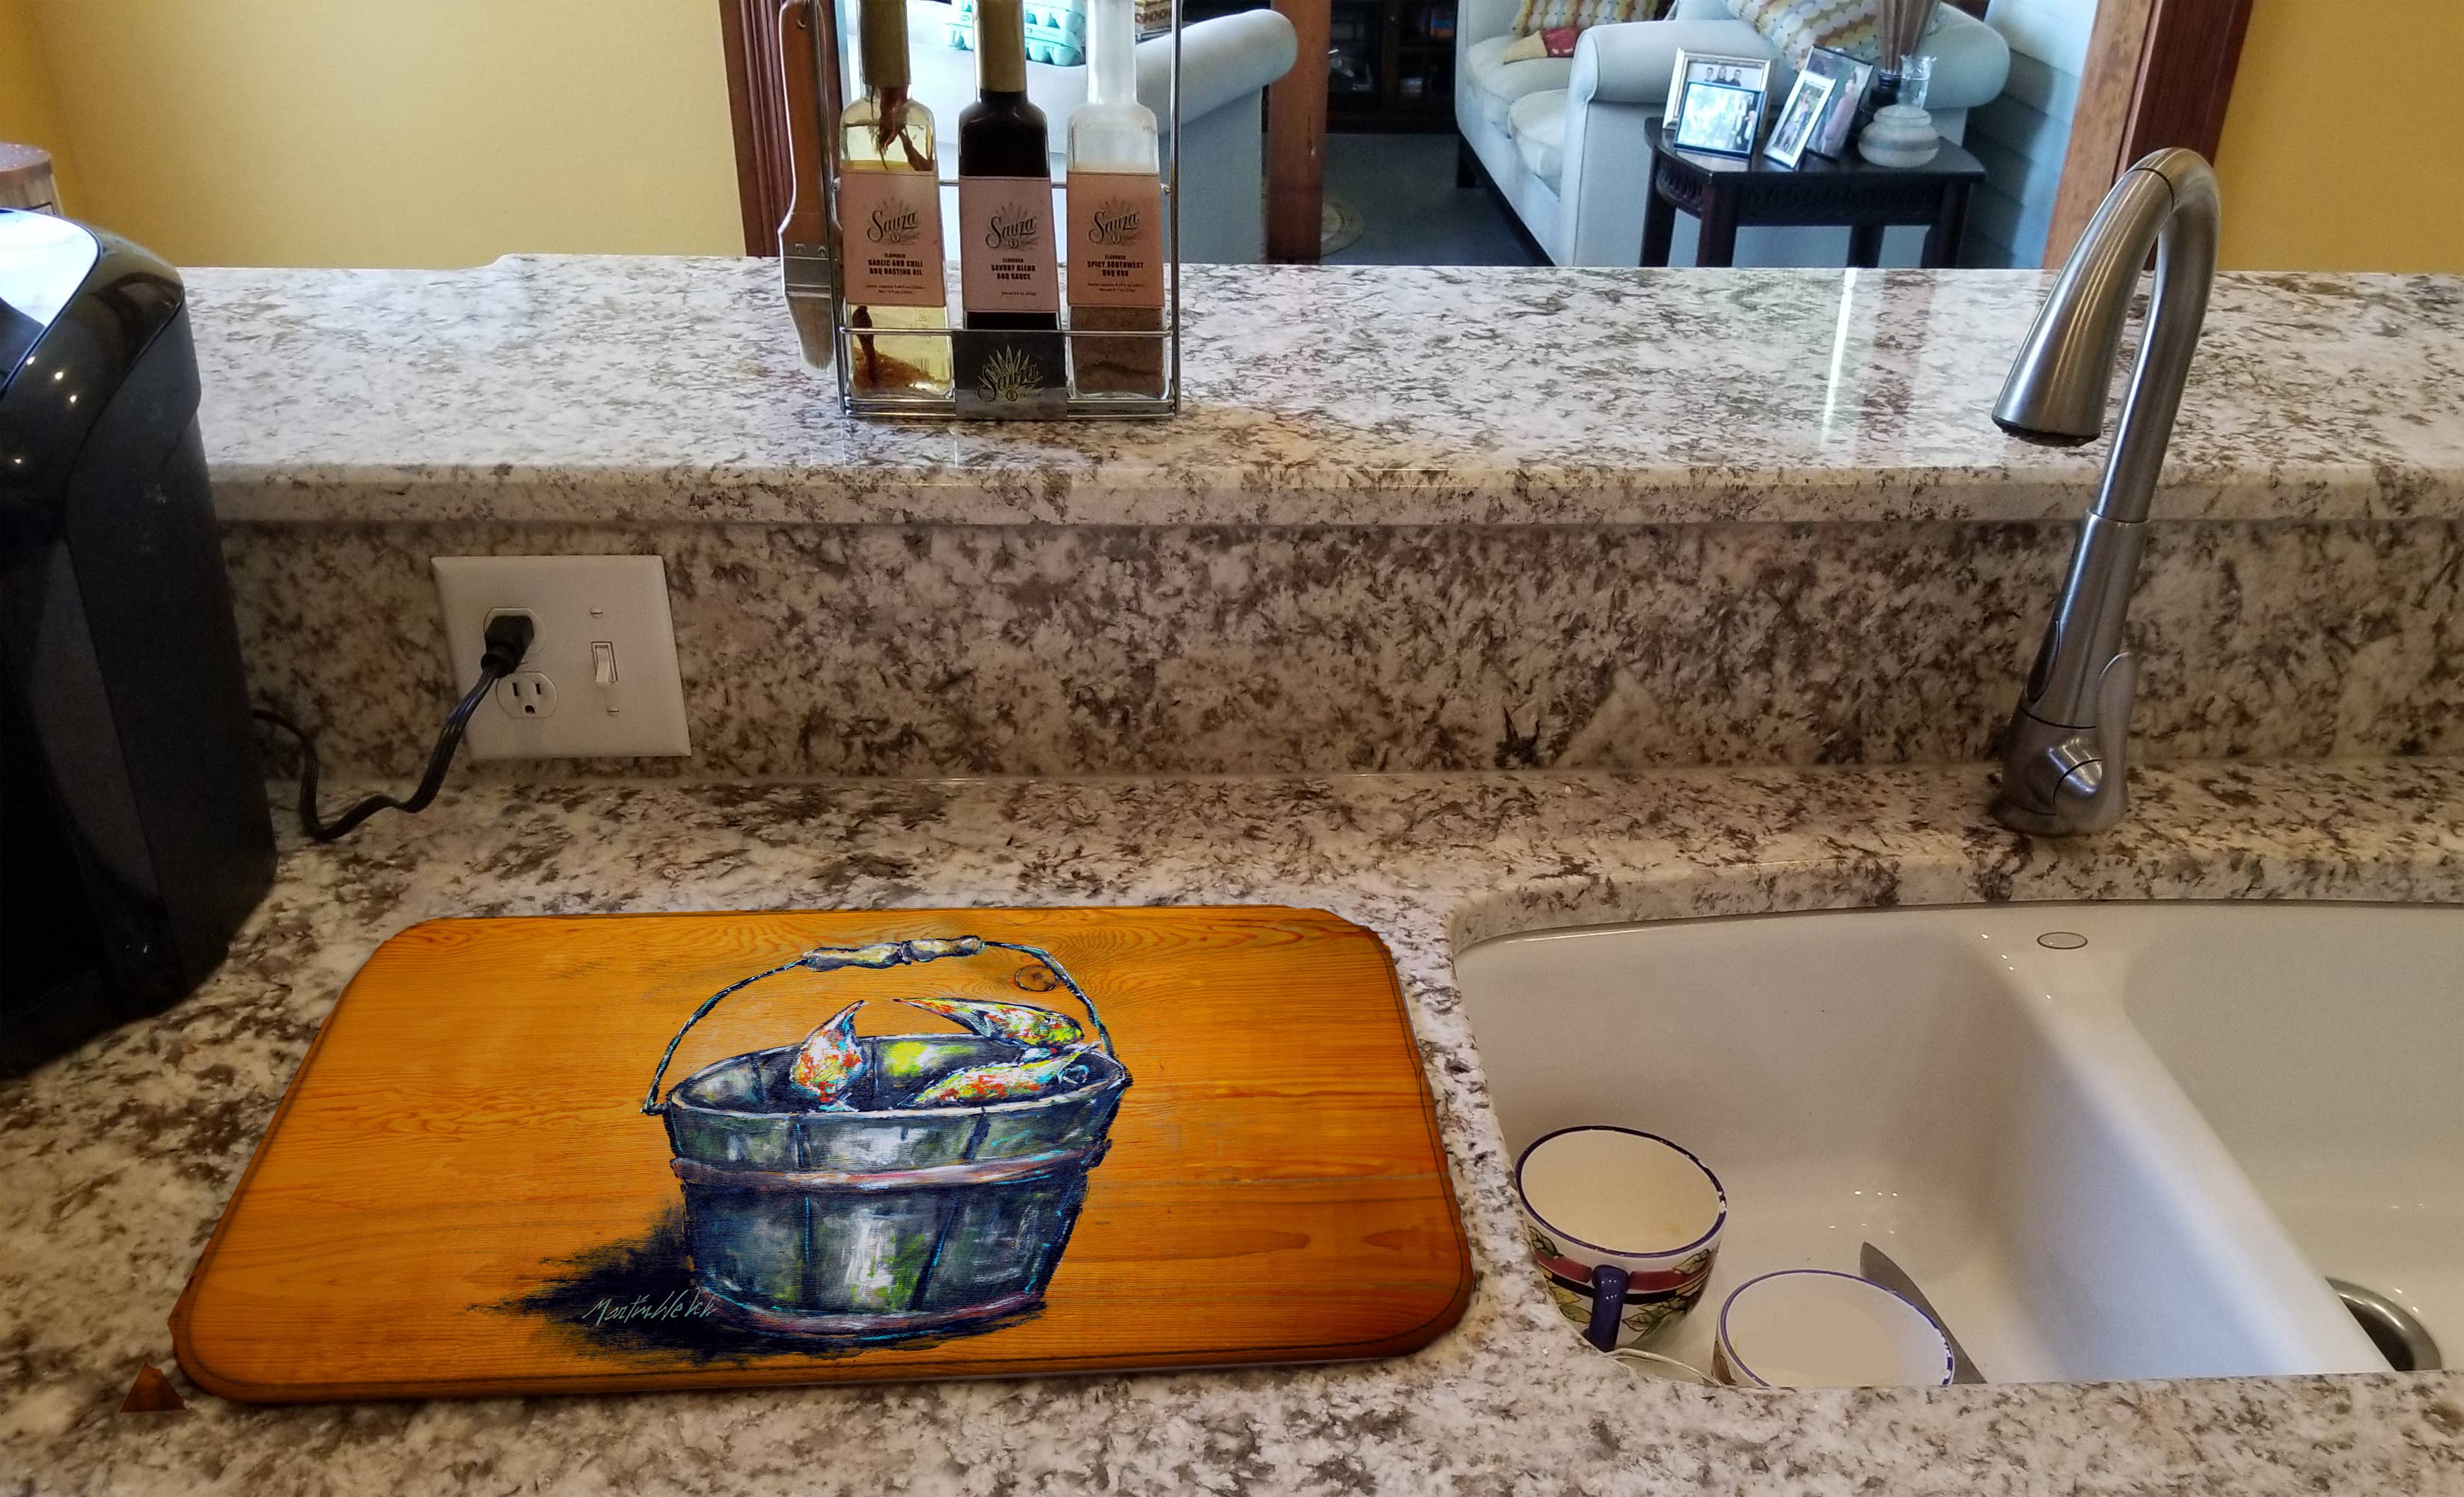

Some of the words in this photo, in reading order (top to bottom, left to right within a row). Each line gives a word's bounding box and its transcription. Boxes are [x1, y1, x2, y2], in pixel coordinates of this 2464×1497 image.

[867, 210, 919, 242] Sauza
[985, 216, 1037, 249] Sauza
[1089, 210, 1140, 244] Sauza
[869, 267, 883, 275] BBQ
[884, 268, 911, 276] BASTING
[997, 272, 1010, 281] BBQ
[1087, 260, 1105, 269] SPICY
[1107, 260, 1144, 269] SOUTHWEST
[977, 363, 1043, 403] Sauza
